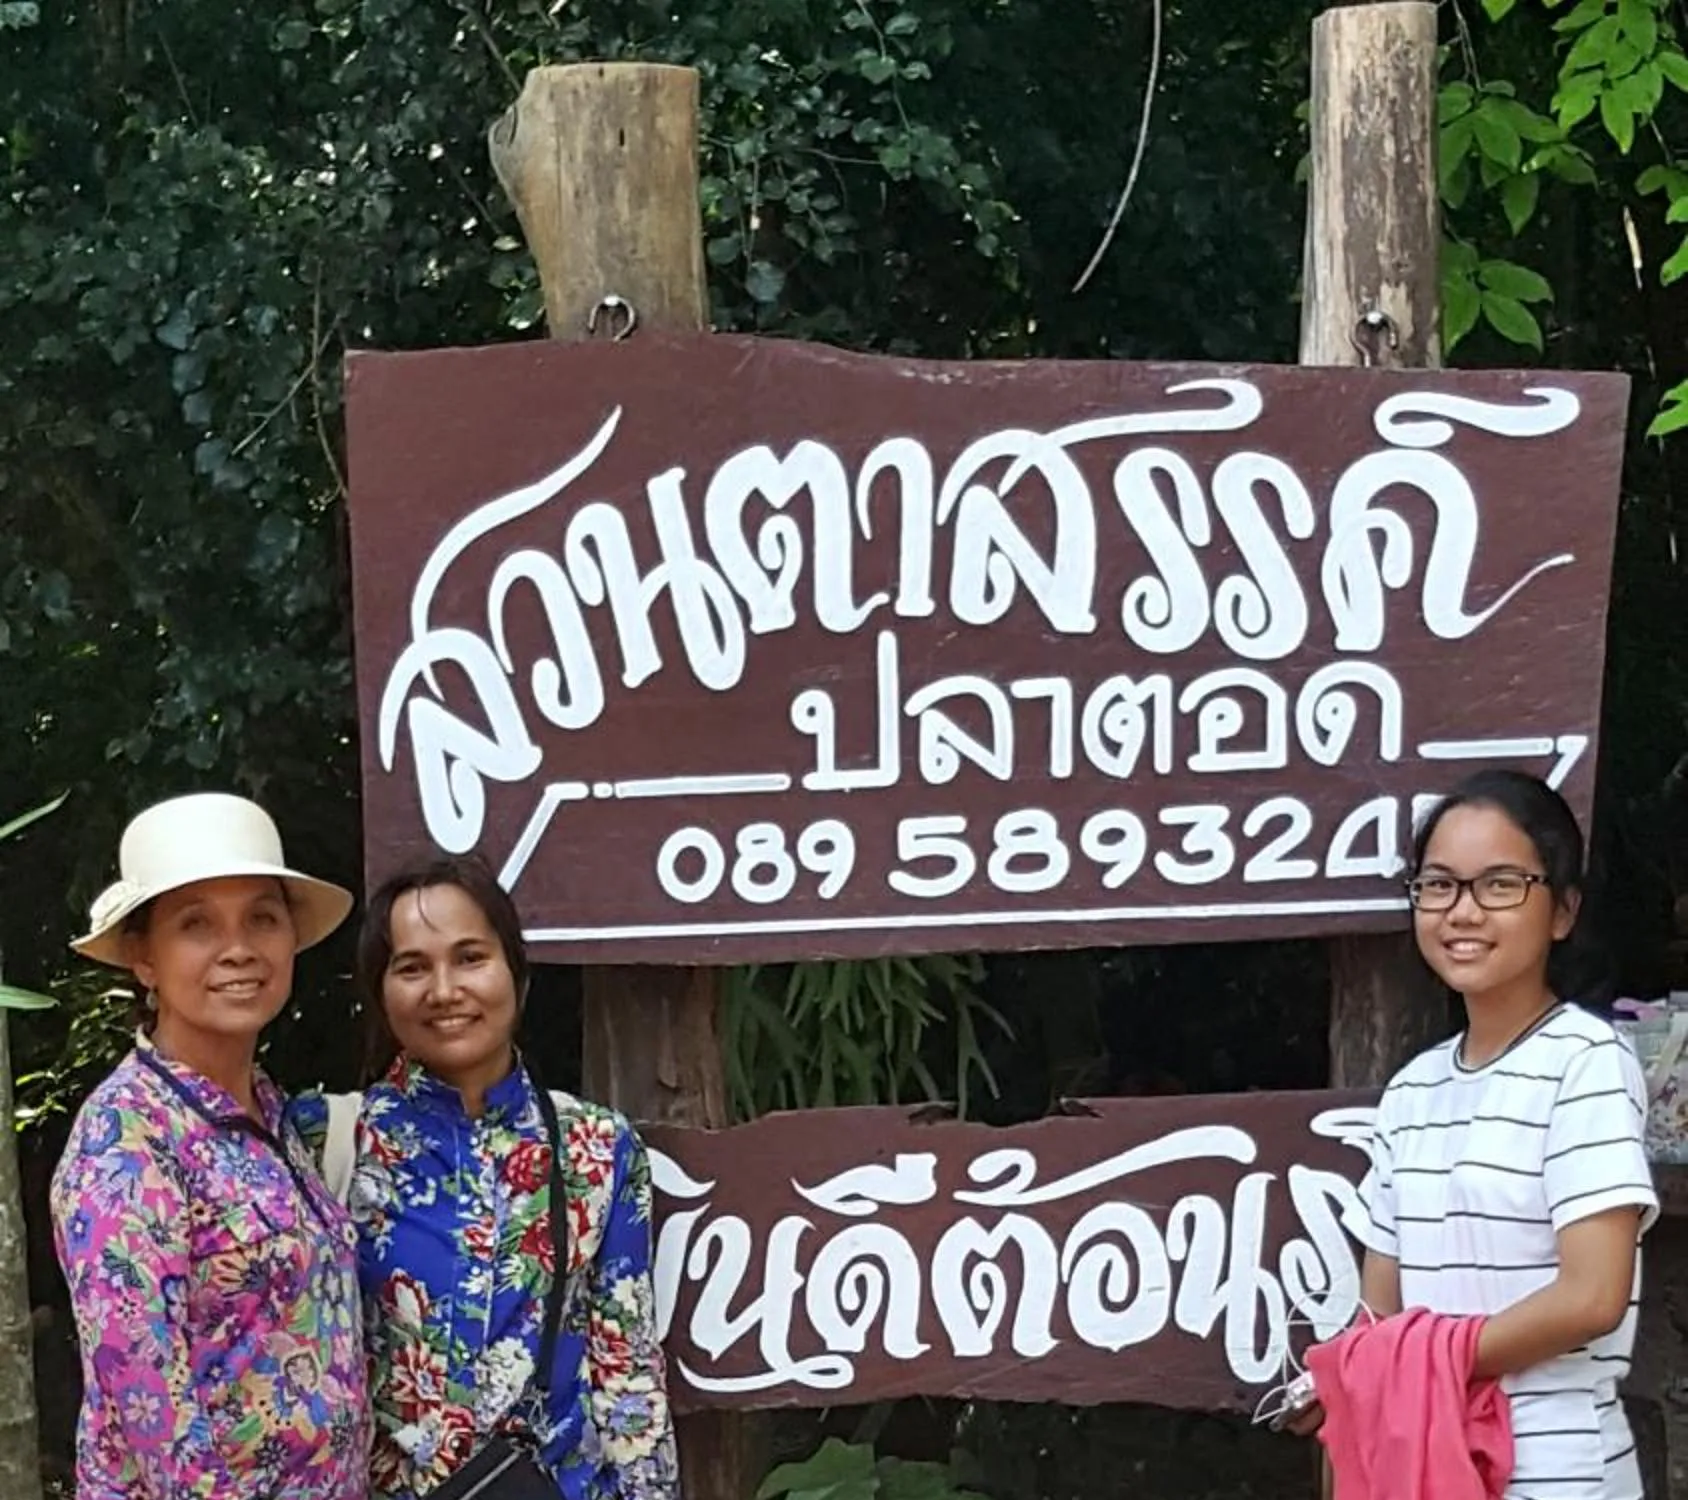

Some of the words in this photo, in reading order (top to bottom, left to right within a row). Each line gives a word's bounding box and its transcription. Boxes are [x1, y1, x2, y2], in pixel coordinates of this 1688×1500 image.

[790, 630, 1402, 790] ปลาตอด
[656, 818, 856, 904] 089
